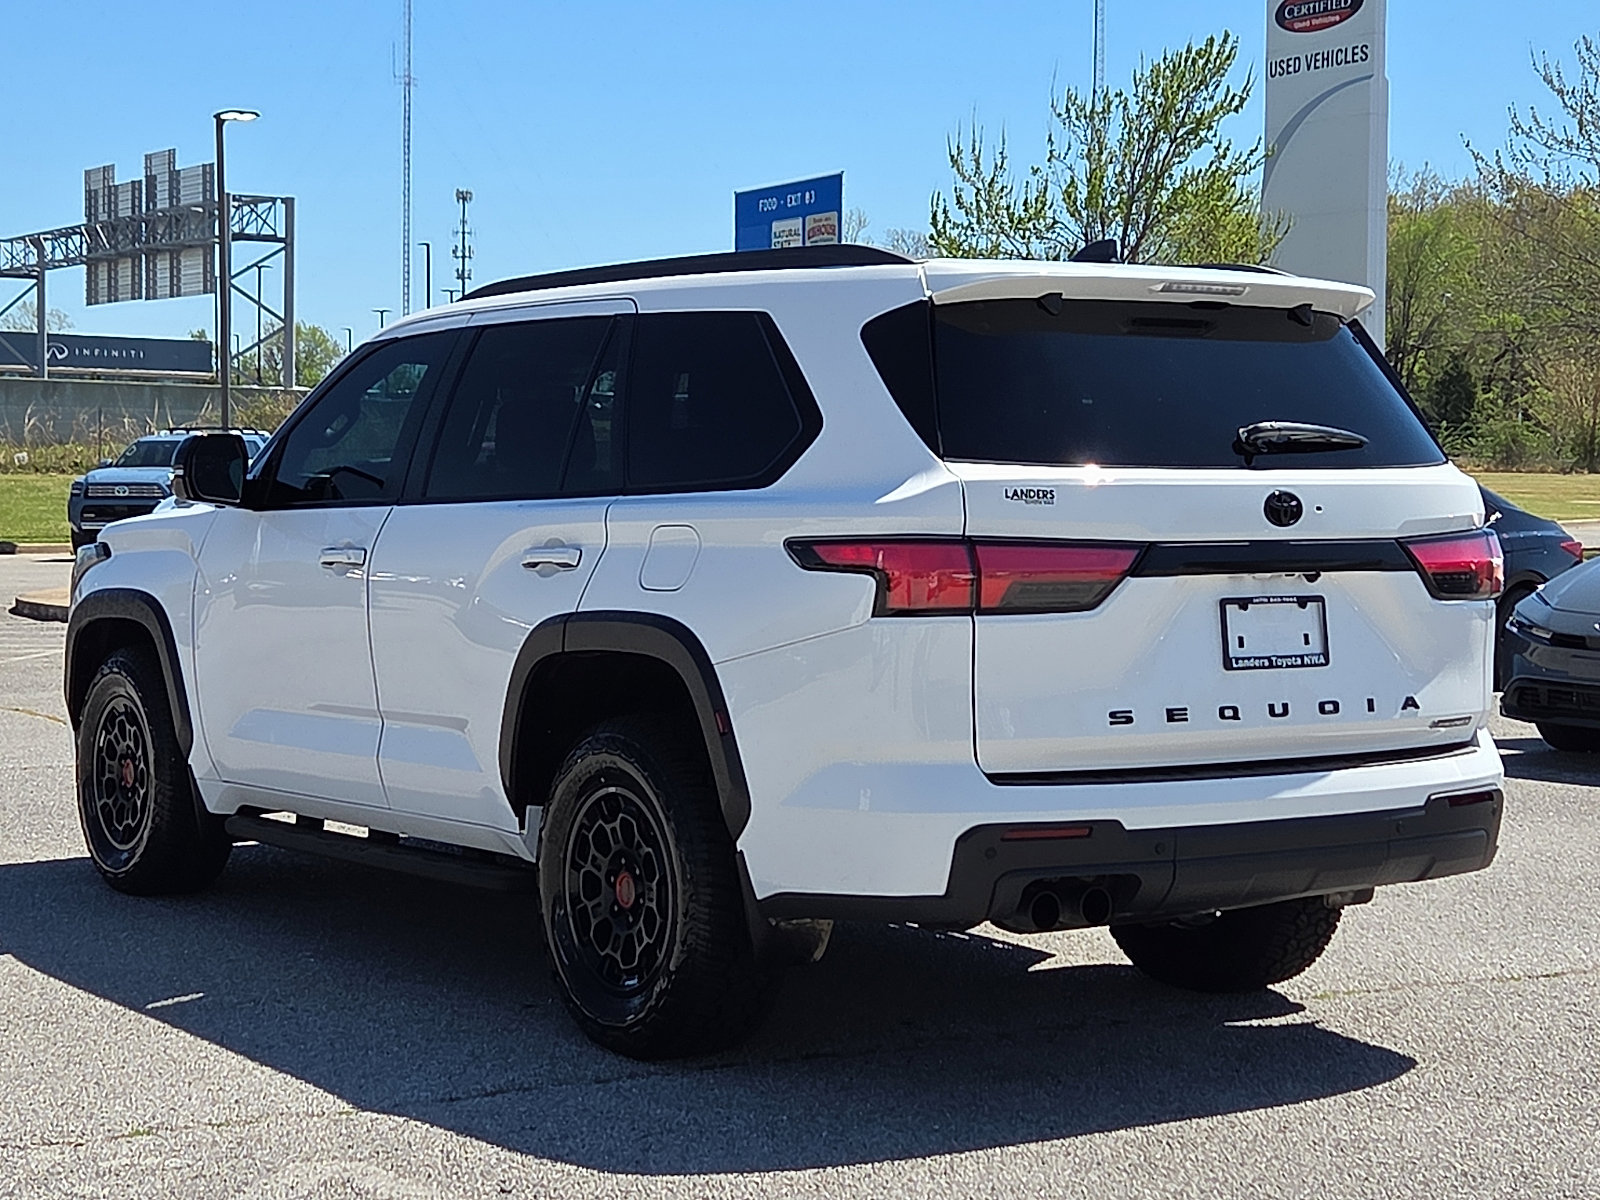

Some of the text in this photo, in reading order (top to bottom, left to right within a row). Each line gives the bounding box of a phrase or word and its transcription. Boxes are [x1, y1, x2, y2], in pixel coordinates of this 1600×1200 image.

[1285, 0, 1352, 19] CERTIFIED
[1269, 44, 1369, 78] USED VEHICLES
[759, 197, 778, 212] FOOD
[787, 193, 802, 208] EXIT
[75, 347, 145, 359] INFINITI
[1005, 488, 1055, 500] LANDERS
[1231, 654, 1326, 668] Landers Toyota NWA
[1108, 695, 1421, 726] SEQUOIA
